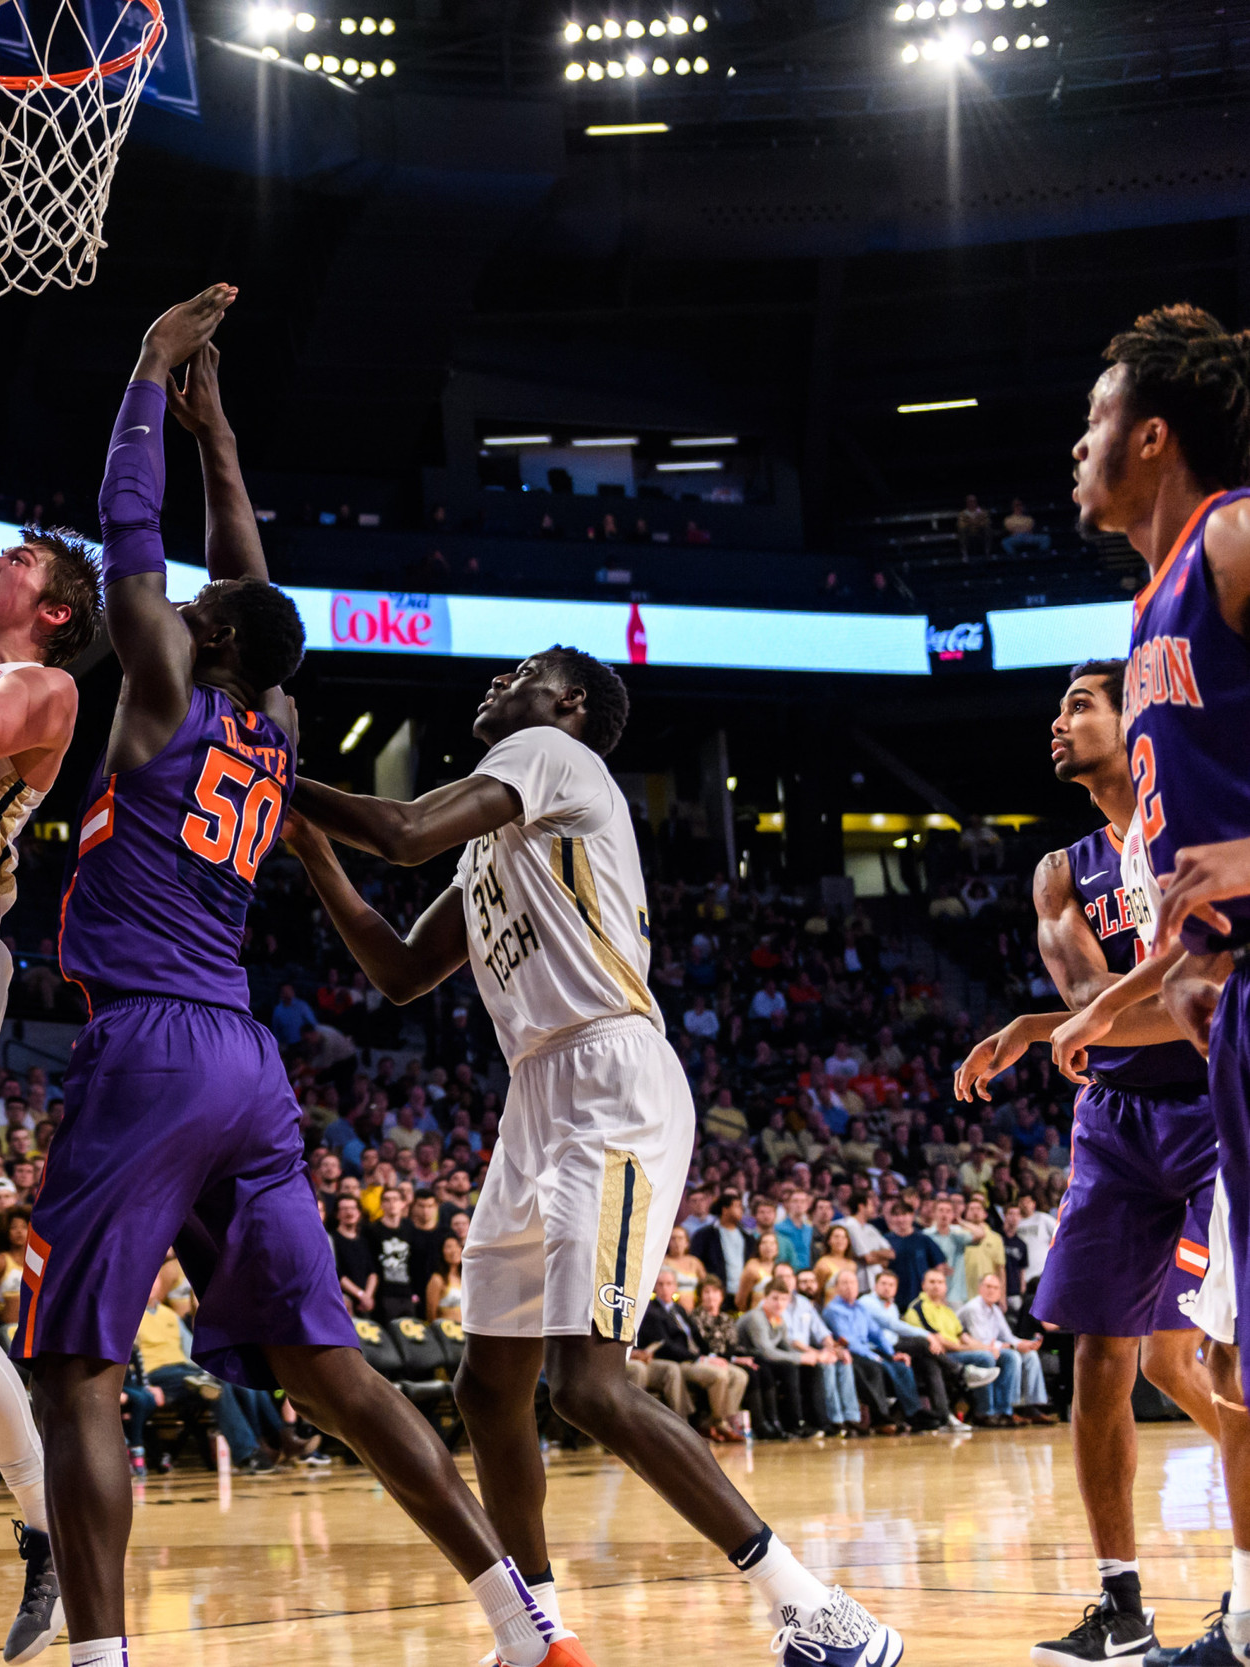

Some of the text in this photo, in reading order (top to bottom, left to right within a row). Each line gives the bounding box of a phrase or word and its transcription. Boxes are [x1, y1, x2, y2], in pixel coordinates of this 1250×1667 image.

[331, 594, 433, 646] Coke
[180, 745, 283, 884] 50
[472, 863, 509, 941] 34
[484, 912, 541, 993] TECH
[598, 1283, 636, 1318] GT
